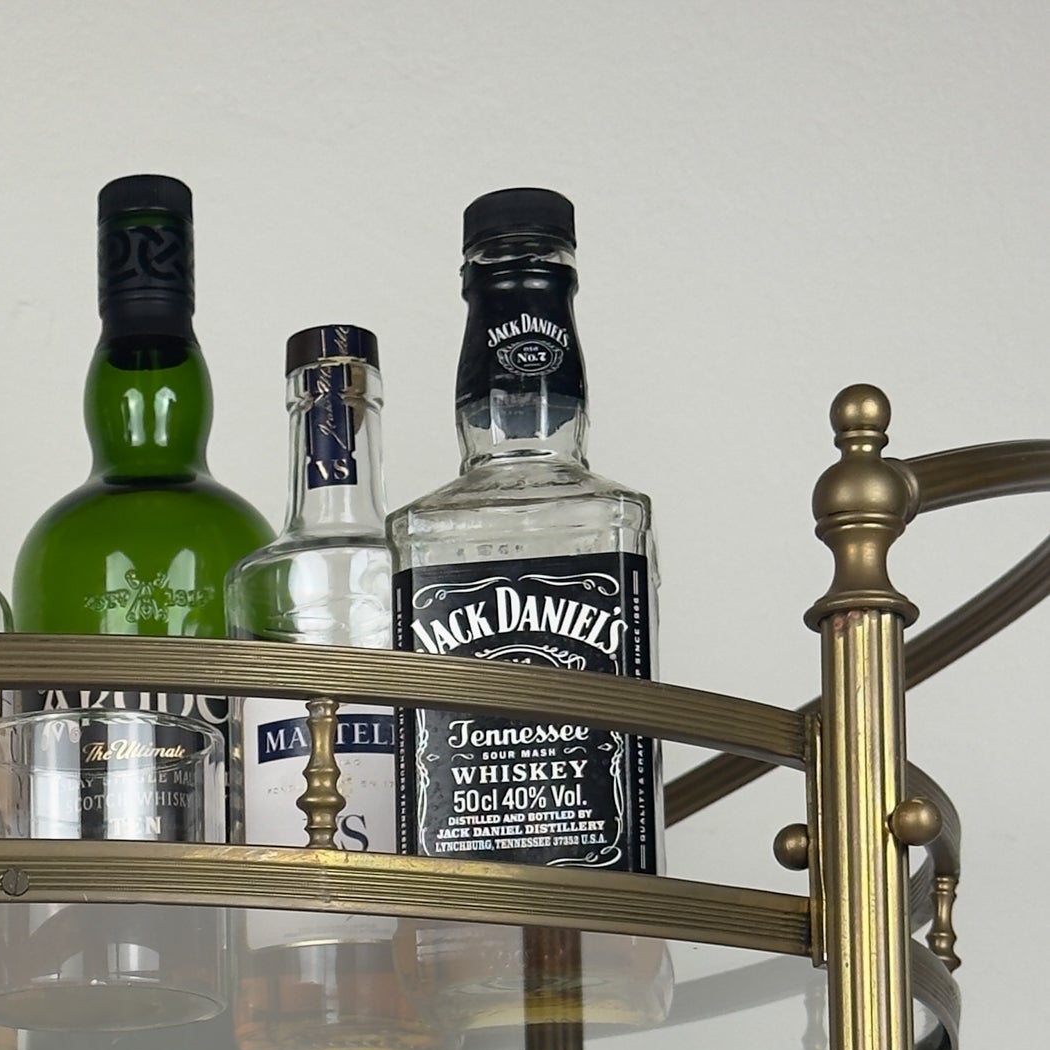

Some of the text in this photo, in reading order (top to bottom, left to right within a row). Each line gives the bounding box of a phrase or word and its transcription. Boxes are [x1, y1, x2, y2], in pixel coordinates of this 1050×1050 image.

[487, 313, 569, 349] JACK DANIEL'S
[517, 352, 547, 364] No.7
[315, 458, 350, 481] VS
[411, 586, 629, 655] JACK DANIEL'S
[448, 719, 589, 749] Tennessee
[83, 738, 186, 763] The Ultimate
[482, 748, 556, 761] SOUR MASH
[173, 769, 195, 786] MAL
[451, 760, 588, 785] WHISKEY
[453, 784, 588, 813] 50cl 40% Vol.
[448, 809, 593, 826] DISTILLED AND BOTTLED BY
[436, 820, 606, 839] JACK DANIEL DISTILLERY
[435, 839, 495, 853] LYNCHBURG,
[495, 836, 552, 850] TENNESSEE
[581, 833, 608, 845] U.S.A.
